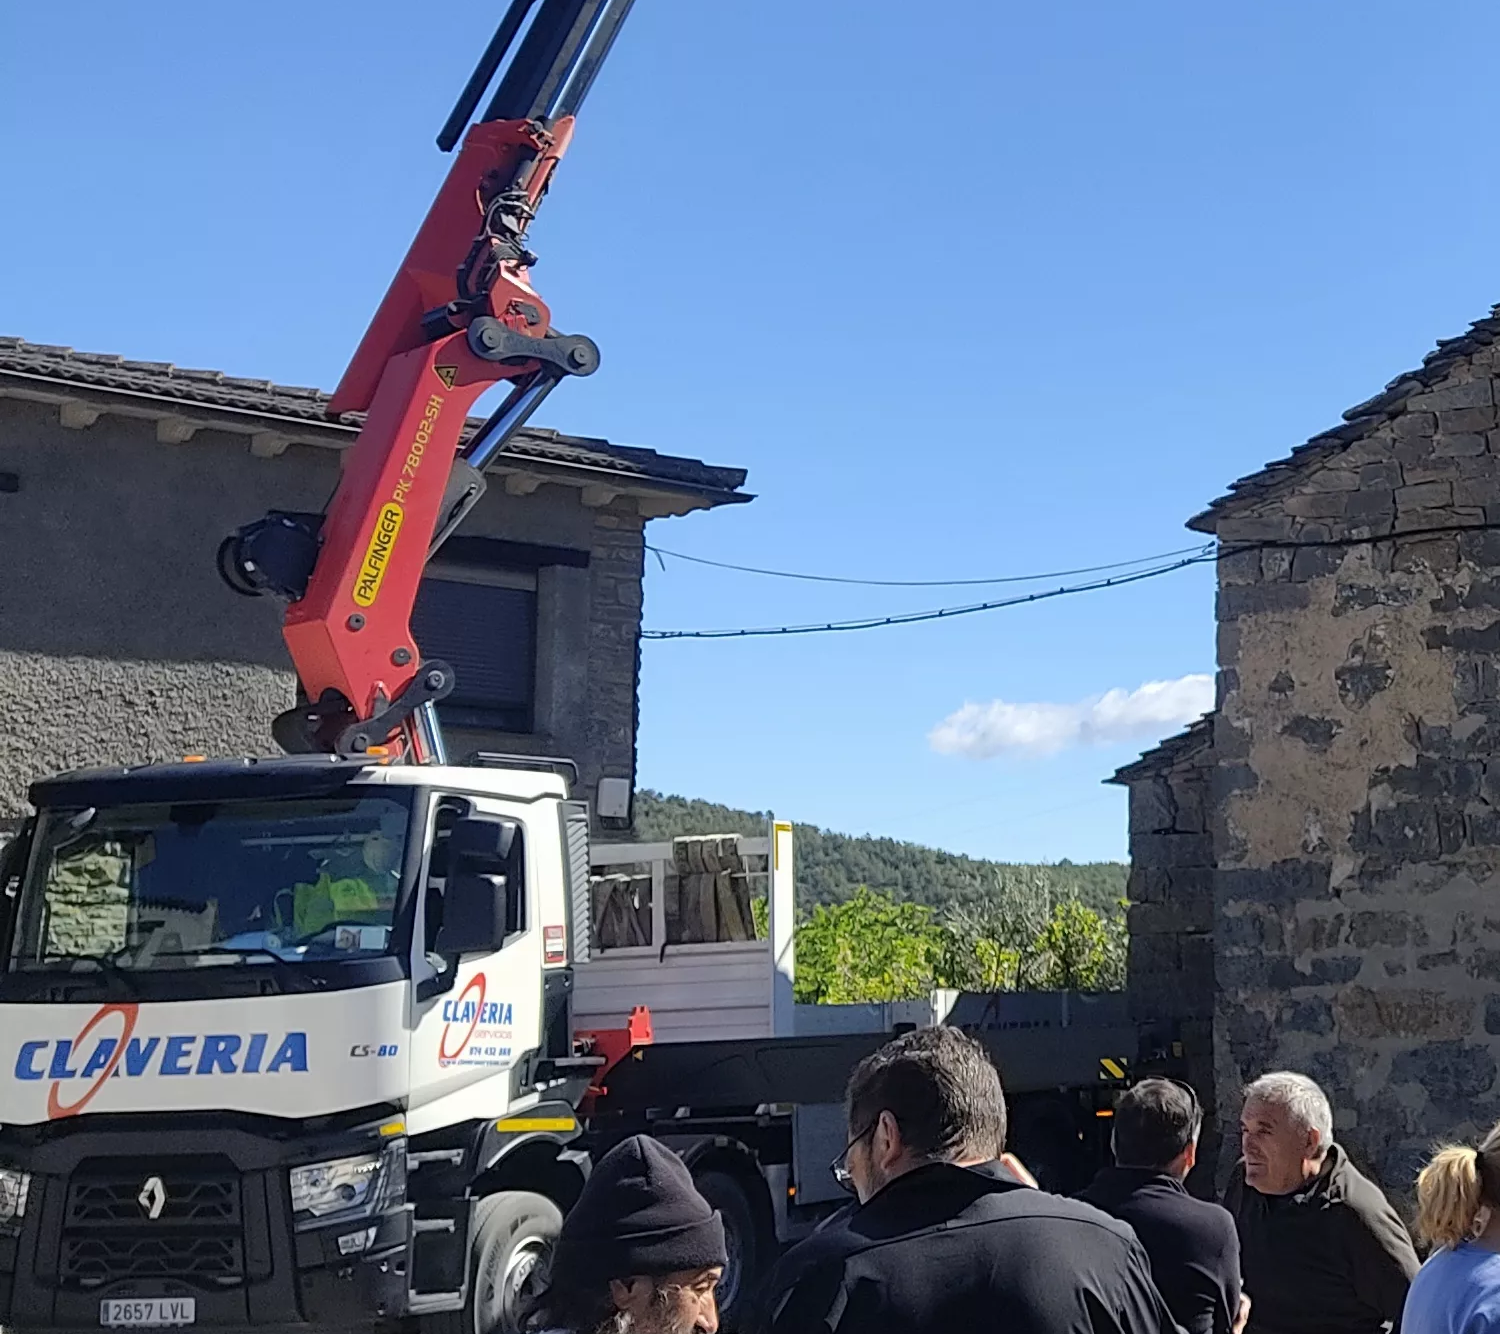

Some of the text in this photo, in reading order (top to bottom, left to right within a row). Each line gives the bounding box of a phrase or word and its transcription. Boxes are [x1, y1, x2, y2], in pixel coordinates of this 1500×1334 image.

[357, 394, 444, 601] PALFINGER PK 78002-SH
[14, 1032, 309, 1081] CLAVERIA
[113, 1302, 190, 1321] 2657 LVL
